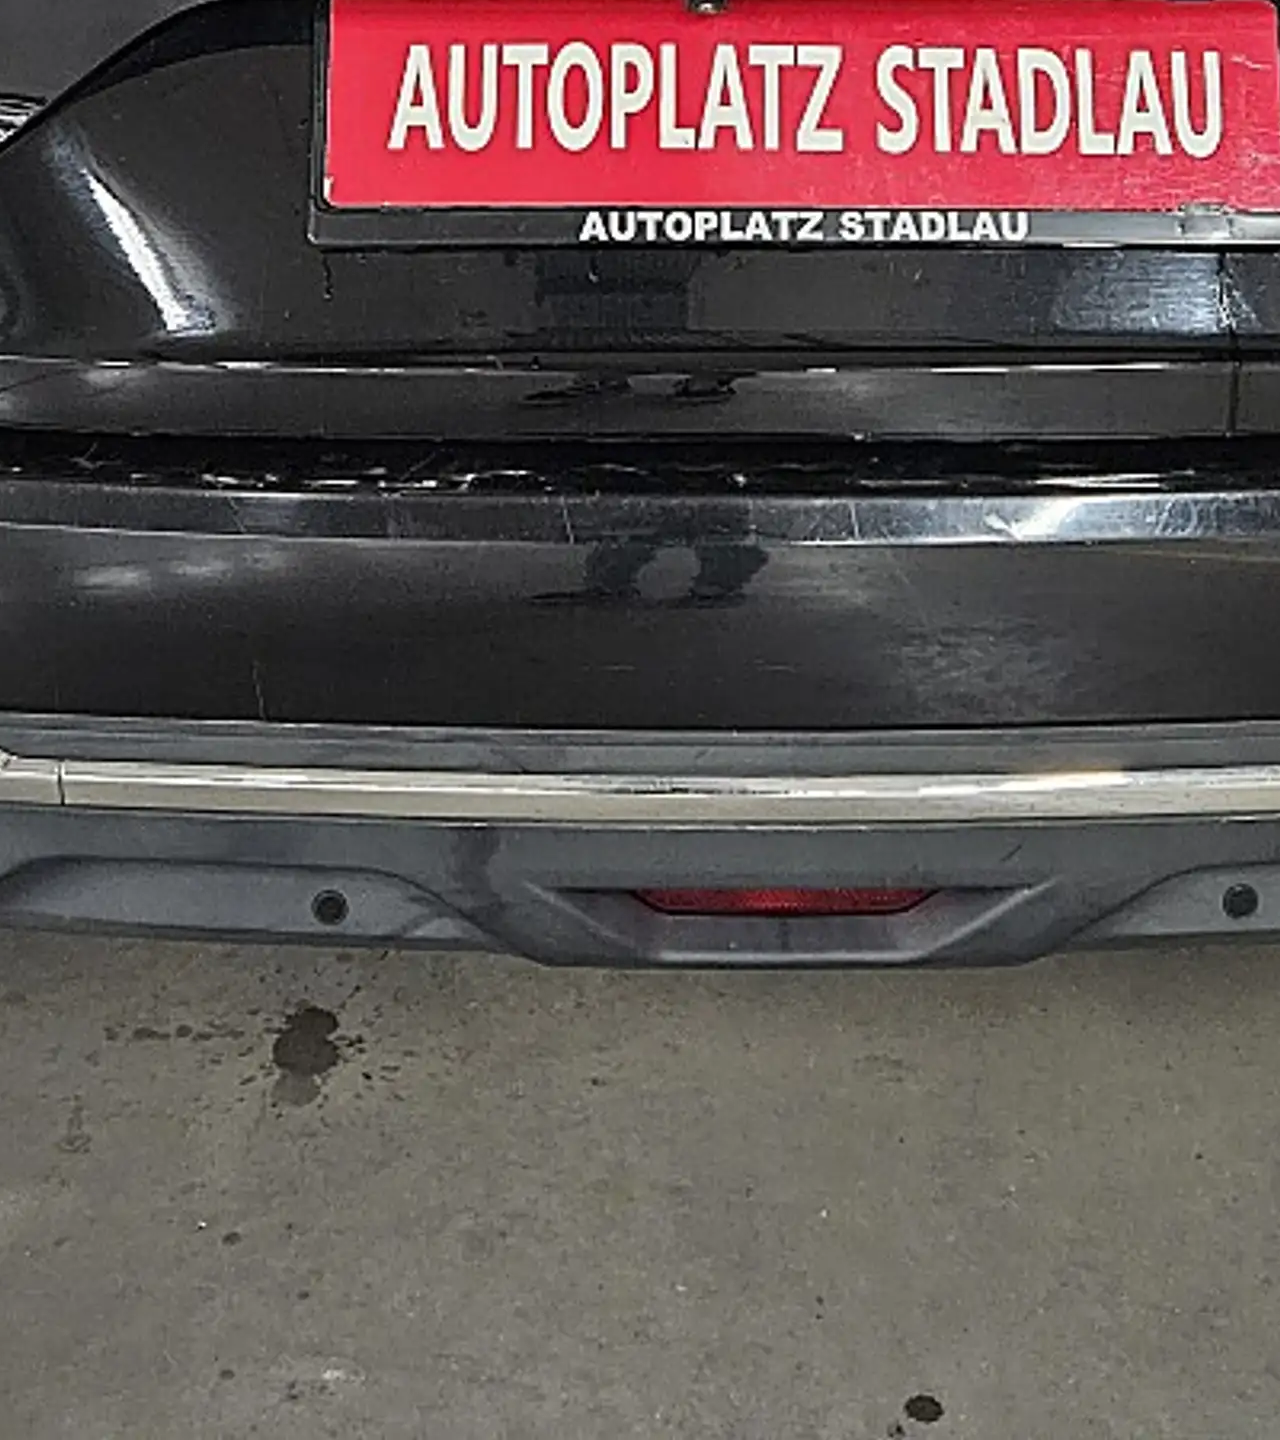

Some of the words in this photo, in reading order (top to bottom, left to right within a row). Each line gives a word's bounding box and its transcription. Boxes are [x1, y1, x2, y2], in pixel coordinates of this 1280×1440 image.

[387, 41, 845, 152] AUTOPLATZ
[874, 46, 1224, 158] STADLAU
[578, 211, 826, 242] AUTOPLATZ
[837, 211, 1030, 243] STADLAU
